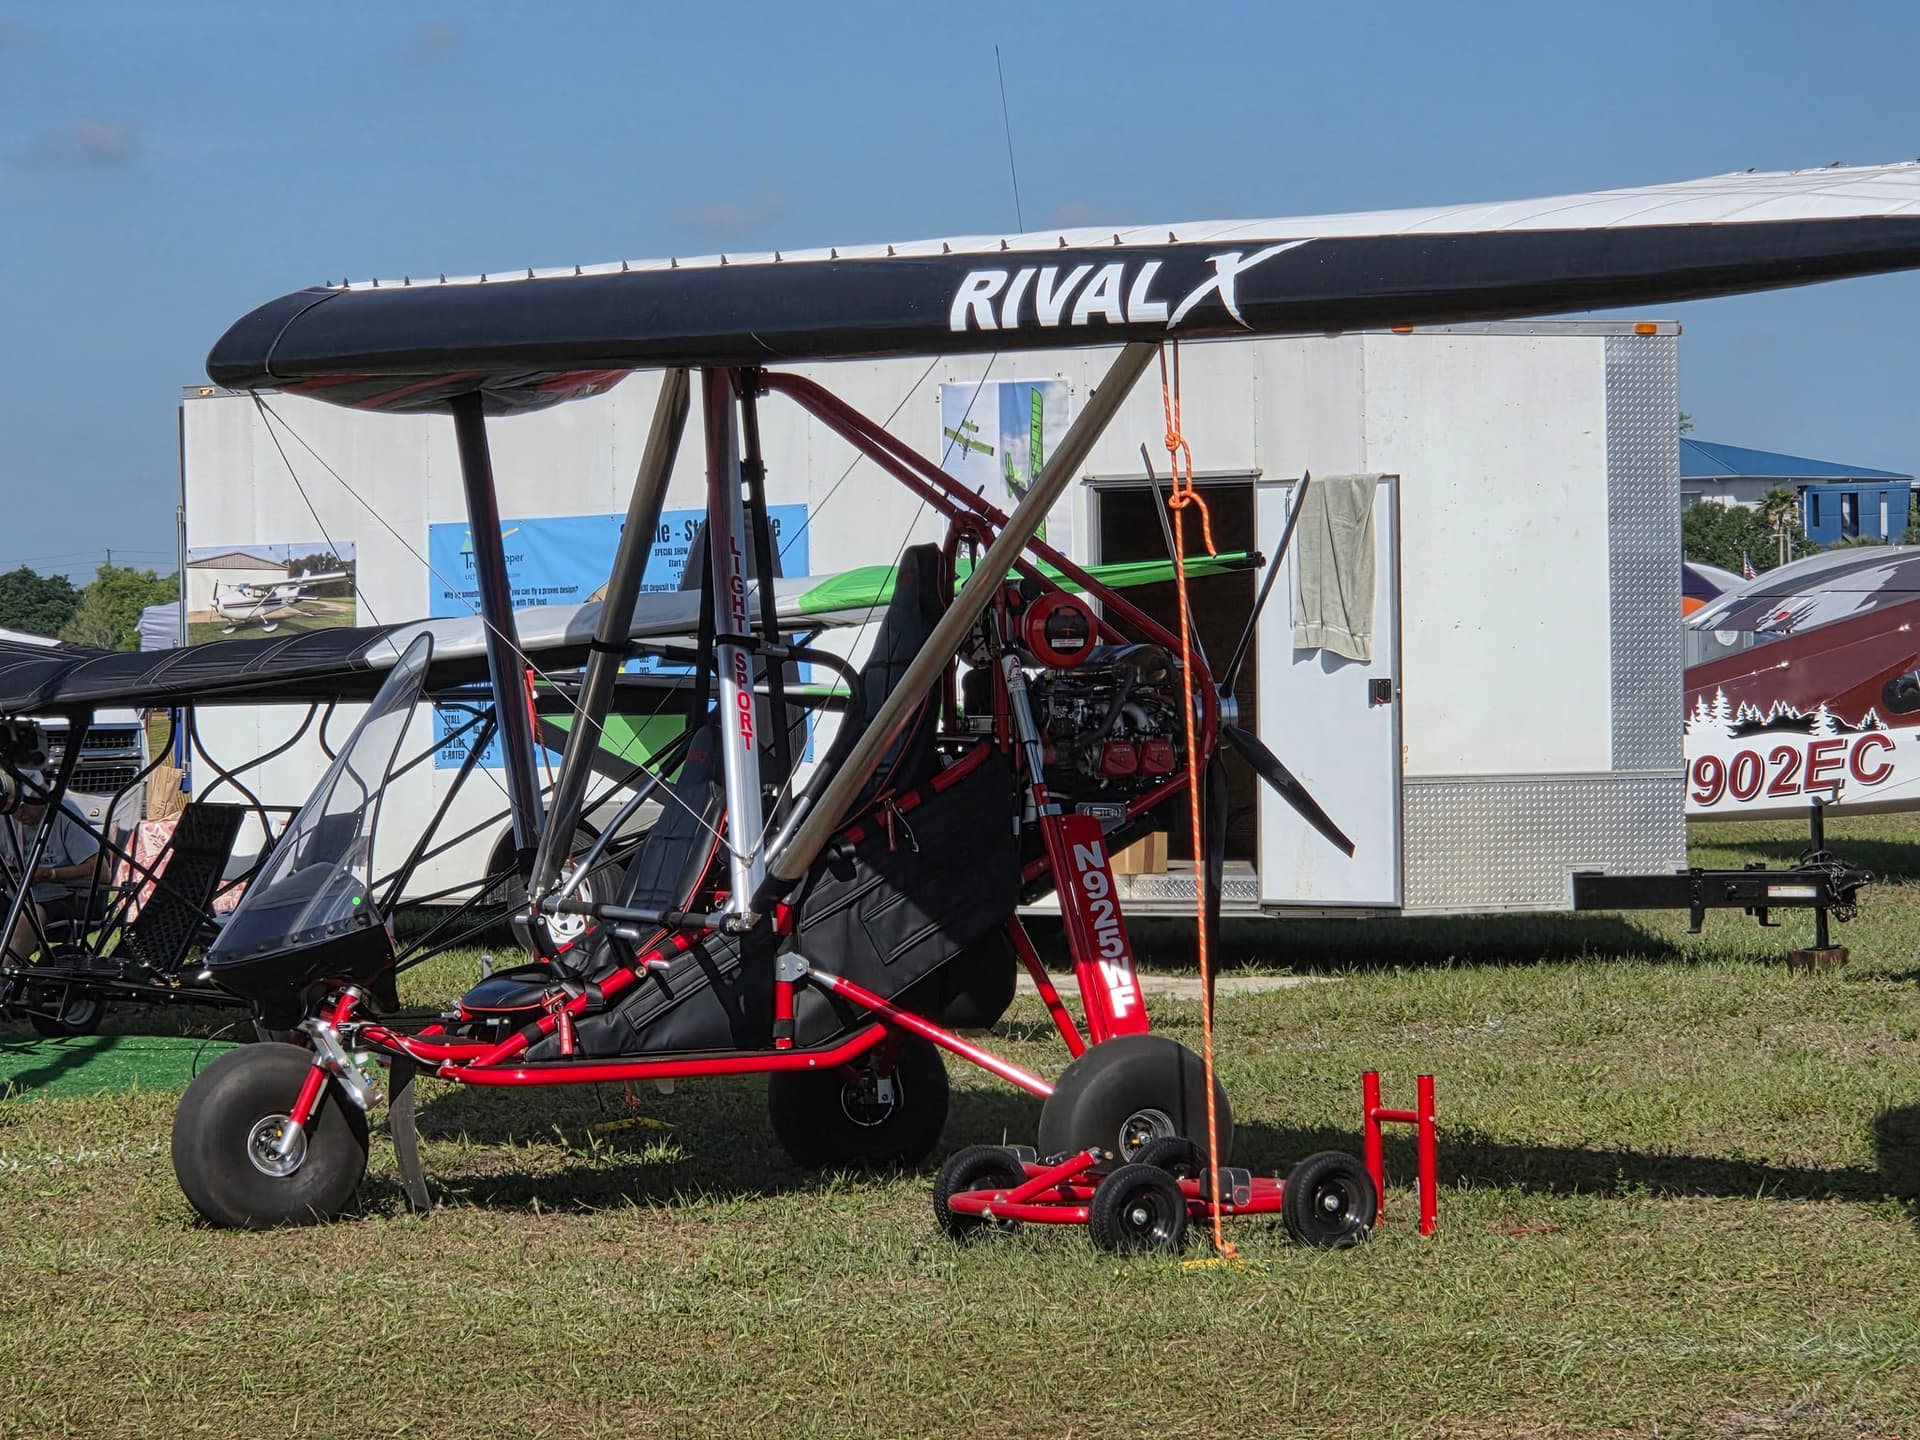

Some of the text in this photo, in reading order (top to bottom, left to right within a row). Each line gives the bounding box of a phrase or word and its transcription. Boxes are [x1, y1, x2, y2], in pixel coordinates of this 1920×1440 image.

[949, 237, 1318, 332] RIVAL X
[729, 536, 745, 633] LIGHT
[735, 652, 753, 750] SPORT
[1684, 733, 1896, 807] 902EC
[1072, 840, 1136, 1018] N925WF
